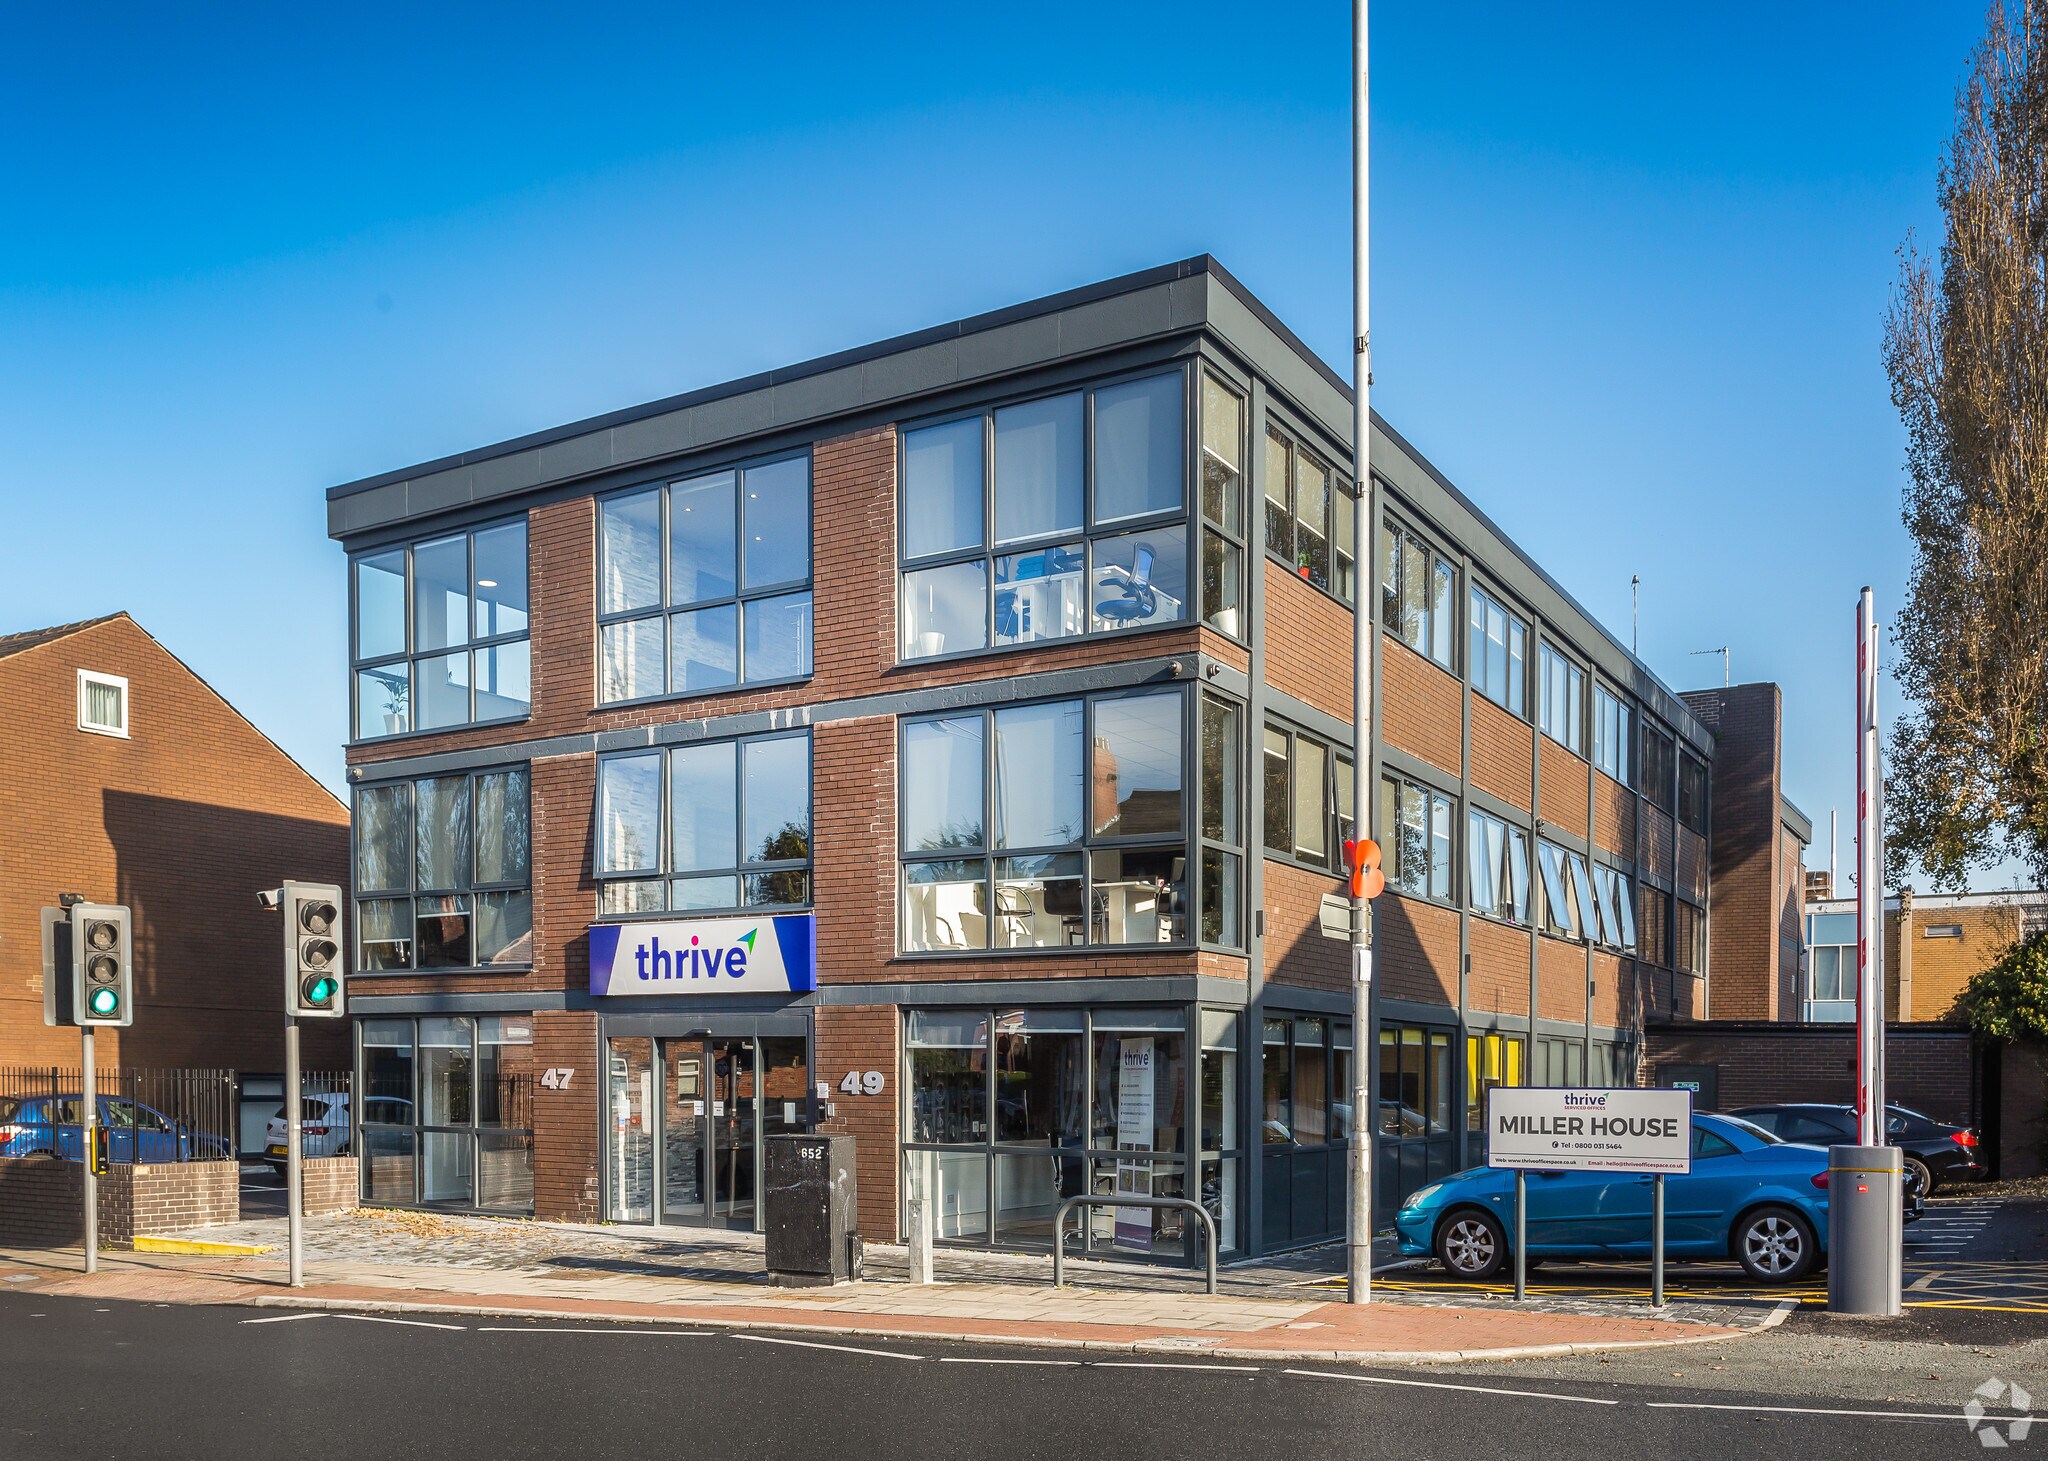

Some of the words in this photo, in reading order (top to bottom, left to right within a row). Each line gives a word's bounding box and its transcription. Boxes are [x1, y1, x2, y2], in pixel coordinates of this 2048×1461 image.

[635, 935, 747, 980] thrive
[1124, 1049, 1149, 1066] thrive
[541, 1068, 575, 1090] 47
[840, 1071, 885, 1095] 49
[1564, 1093, 1606, 1105] thrive
[1500, 1116, 1584, 1135] MILLER
[1591, 1117, 1678, 1137] HOUSE
[801, 1148, 822, 1160] 652
[1606, 1161, 1684, 1169] hello@thriveofficespace.co.uk
